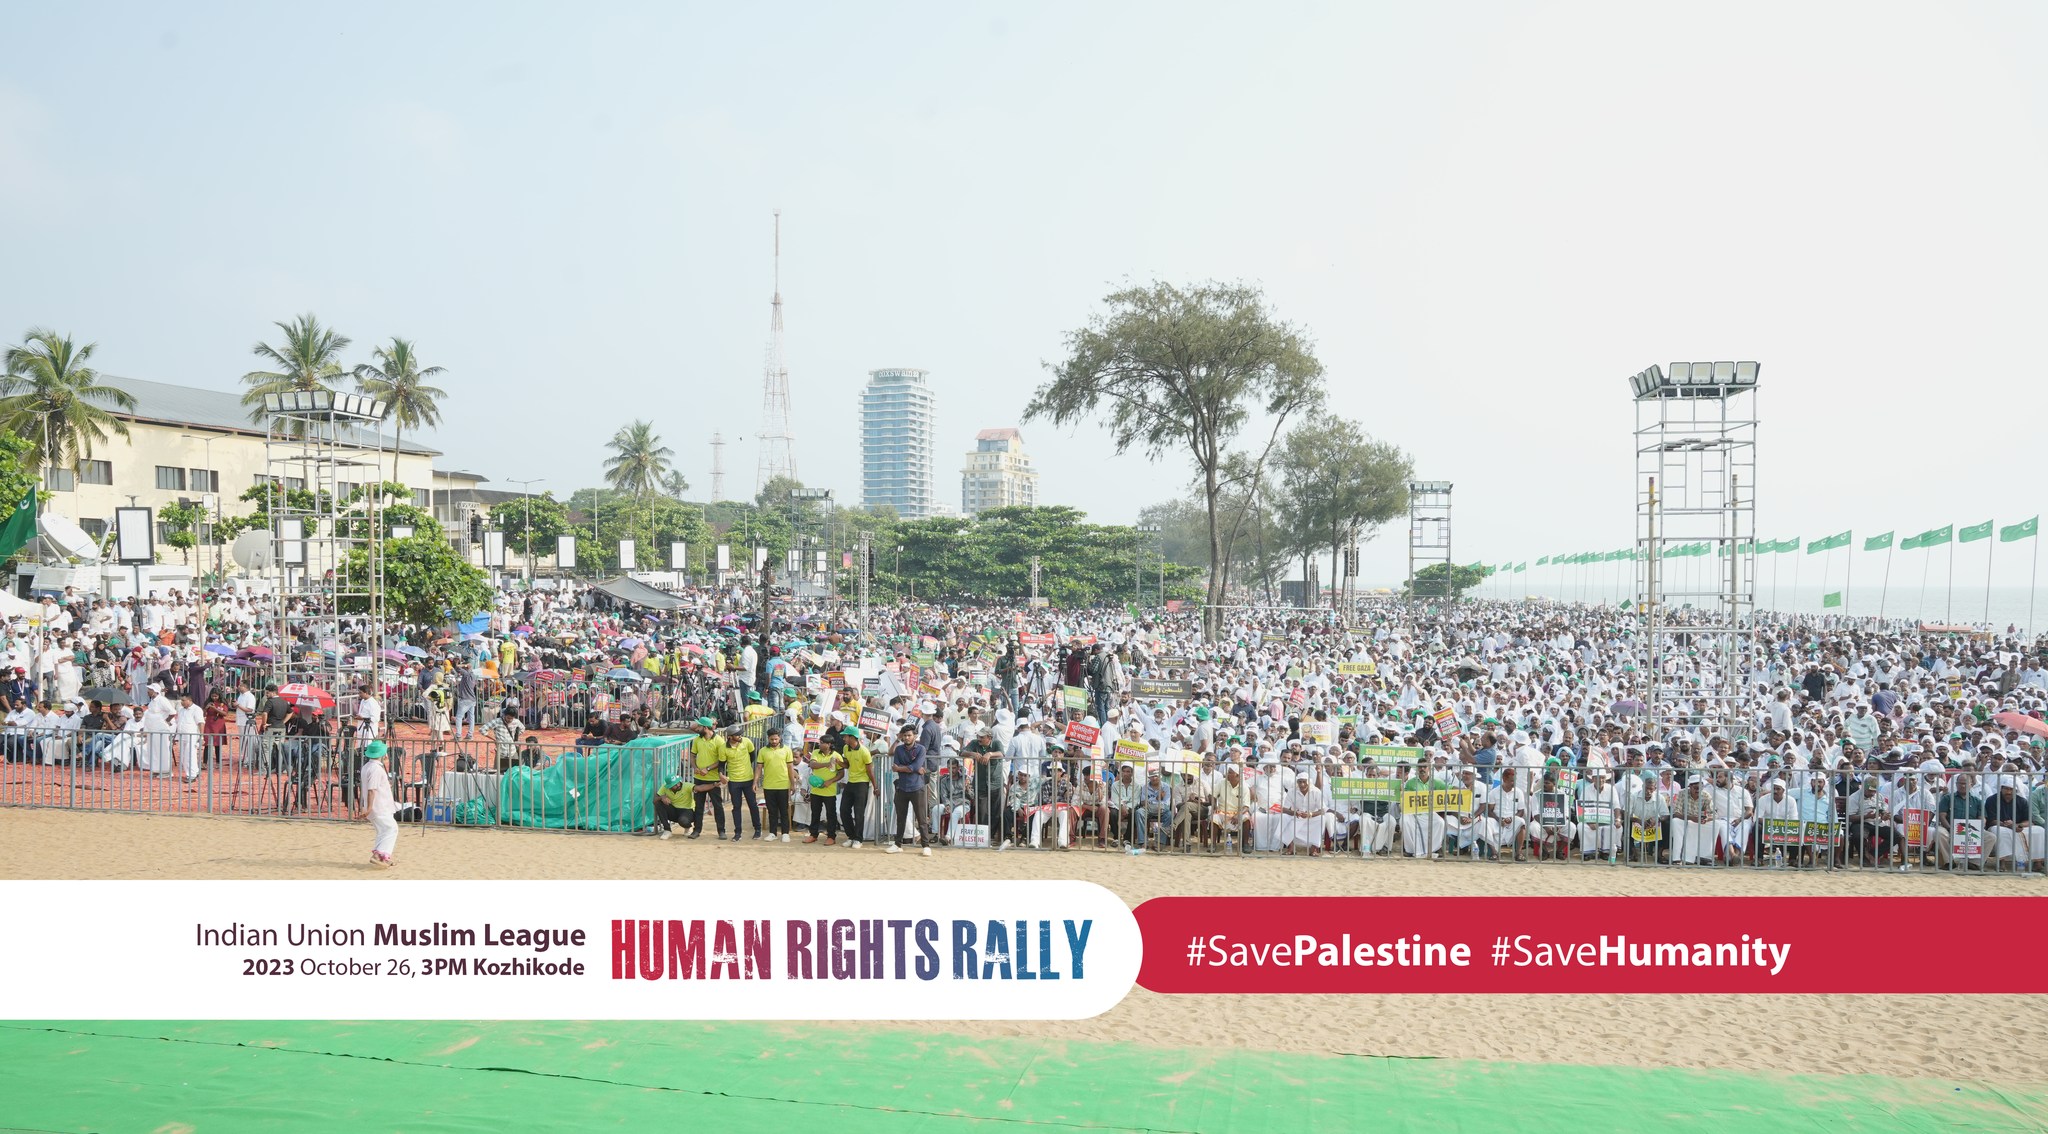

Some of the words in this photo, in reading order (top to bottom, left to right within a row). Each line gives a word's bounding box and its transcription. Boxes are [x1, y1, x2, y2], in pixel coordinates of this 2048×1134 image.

[862, 711, 876, 719] INDIA
[876, 714, 889, 722] WITH
[862, 718, 886, 729] PALESTINE
[1118, 747, 1145, 758] PALESTINE
[1409, 796, 1432, 807] FRE
[1436, 794, 1463, 806] GAZA
